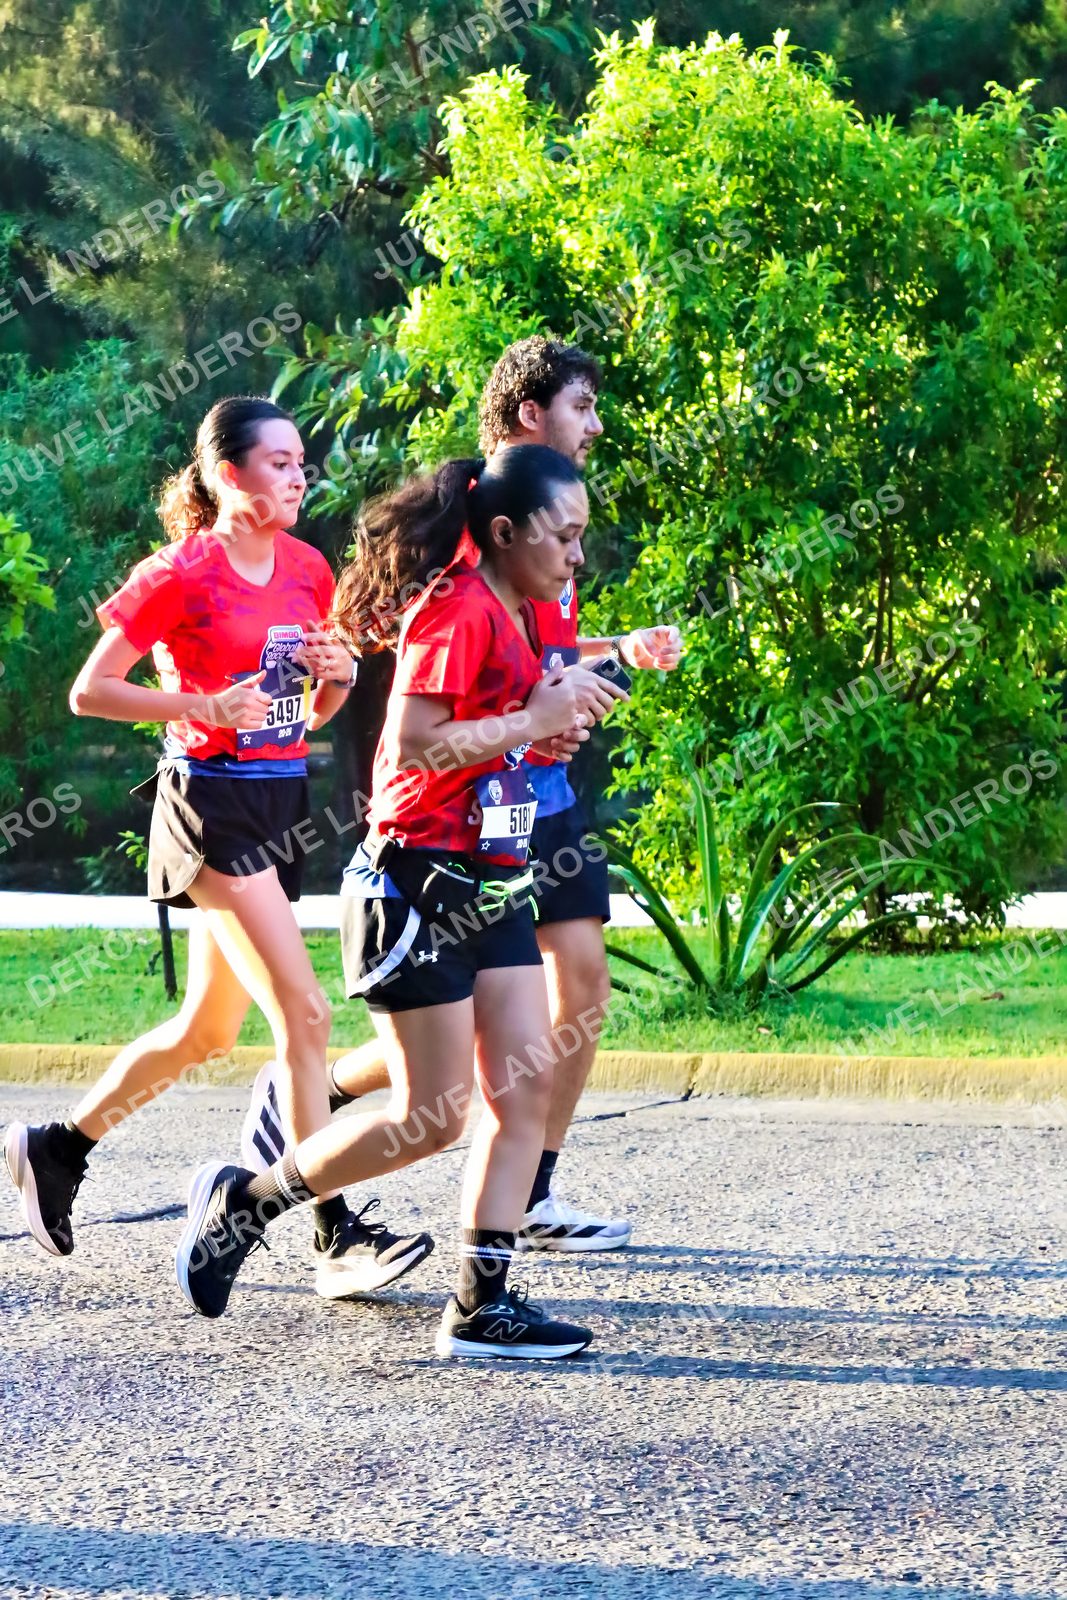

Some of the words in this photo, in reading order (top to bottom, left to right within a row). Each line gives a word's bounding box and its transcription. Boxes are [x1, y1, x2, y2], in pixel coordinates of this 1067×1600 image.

[273, 631, 299, 639] BIMBO
[266, 697, 301, 727] 5497
[510, 806, 531, 834] 5181
